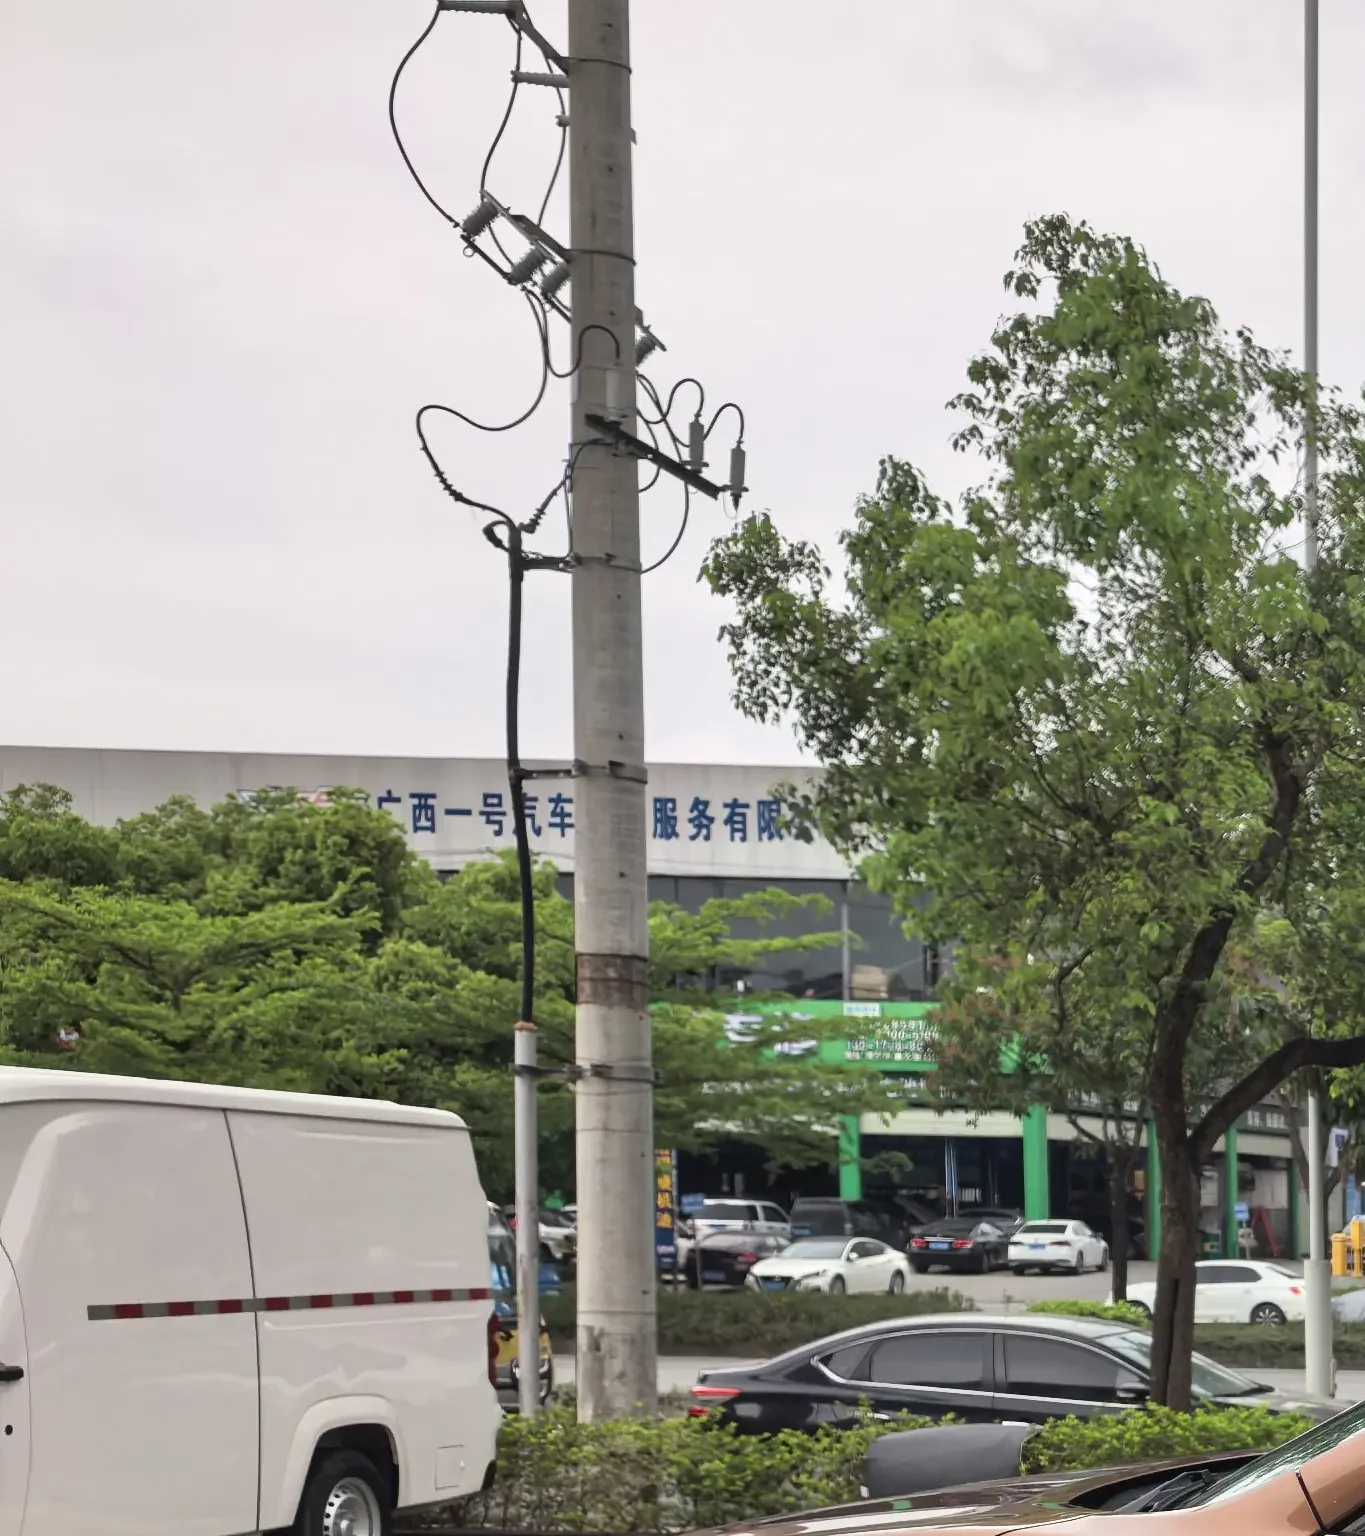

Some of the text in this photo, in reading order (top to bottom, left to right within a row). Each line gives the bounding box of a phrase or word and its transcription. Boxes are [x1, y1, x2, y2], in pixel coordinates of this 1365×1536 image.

[376, 789, 815, 843] 广西一号汽车服务有限
